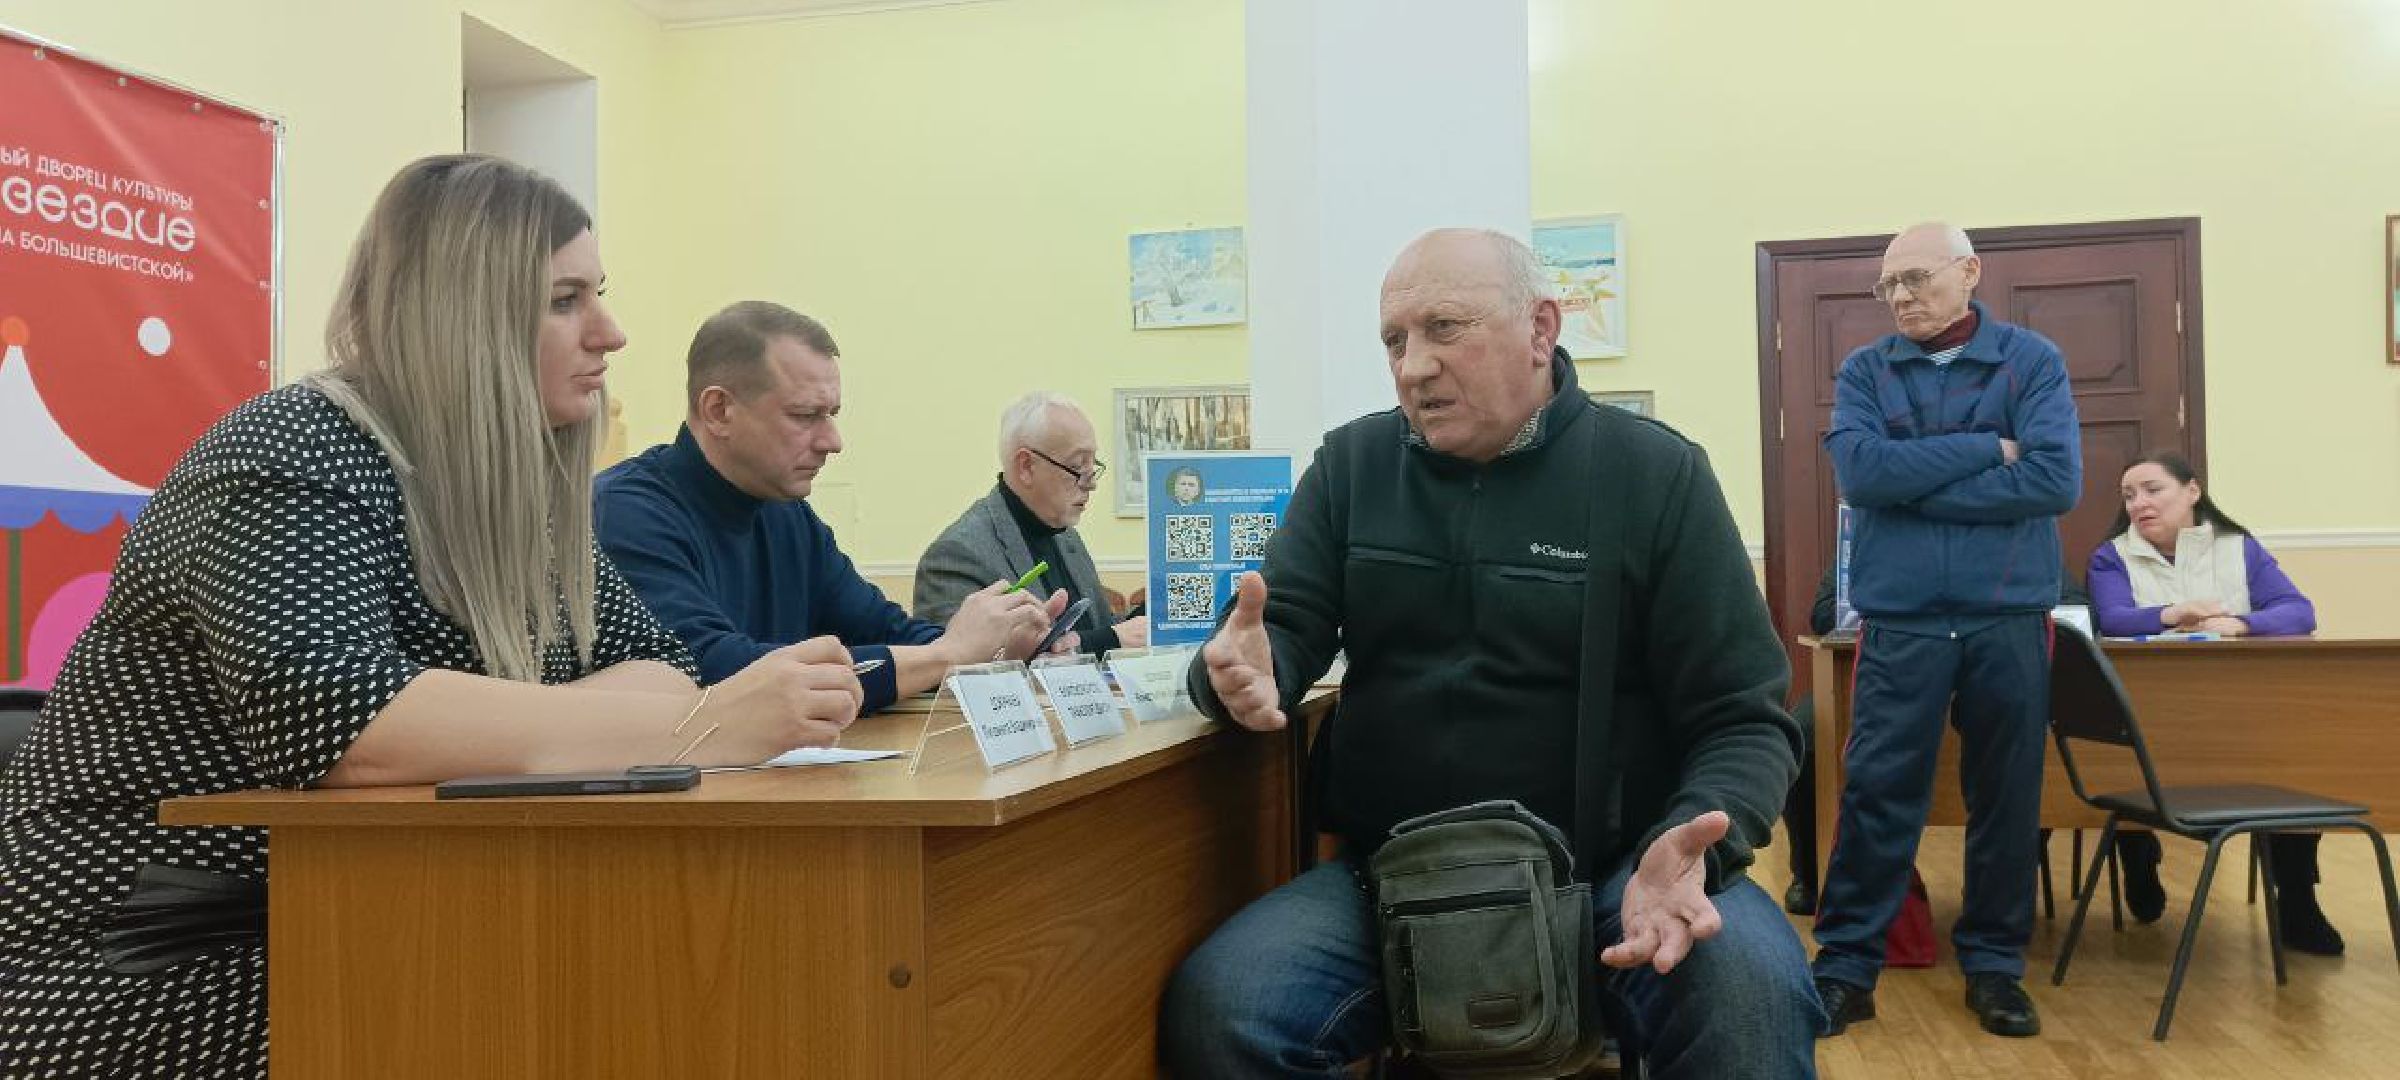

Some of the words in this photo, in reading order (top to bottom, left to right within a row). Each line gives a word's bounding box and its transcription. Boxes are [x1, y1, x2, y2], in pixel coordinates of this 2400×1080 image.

[35, 154, 107, 192] ДВОРЕЦ
[112, 176, 193, 211] КУЛЬТУРЫ
[19, 231, 194, 282] БОЛЬШЕВИСТСКОЙ»
[1542, 544, 1589, 559] Columbi
